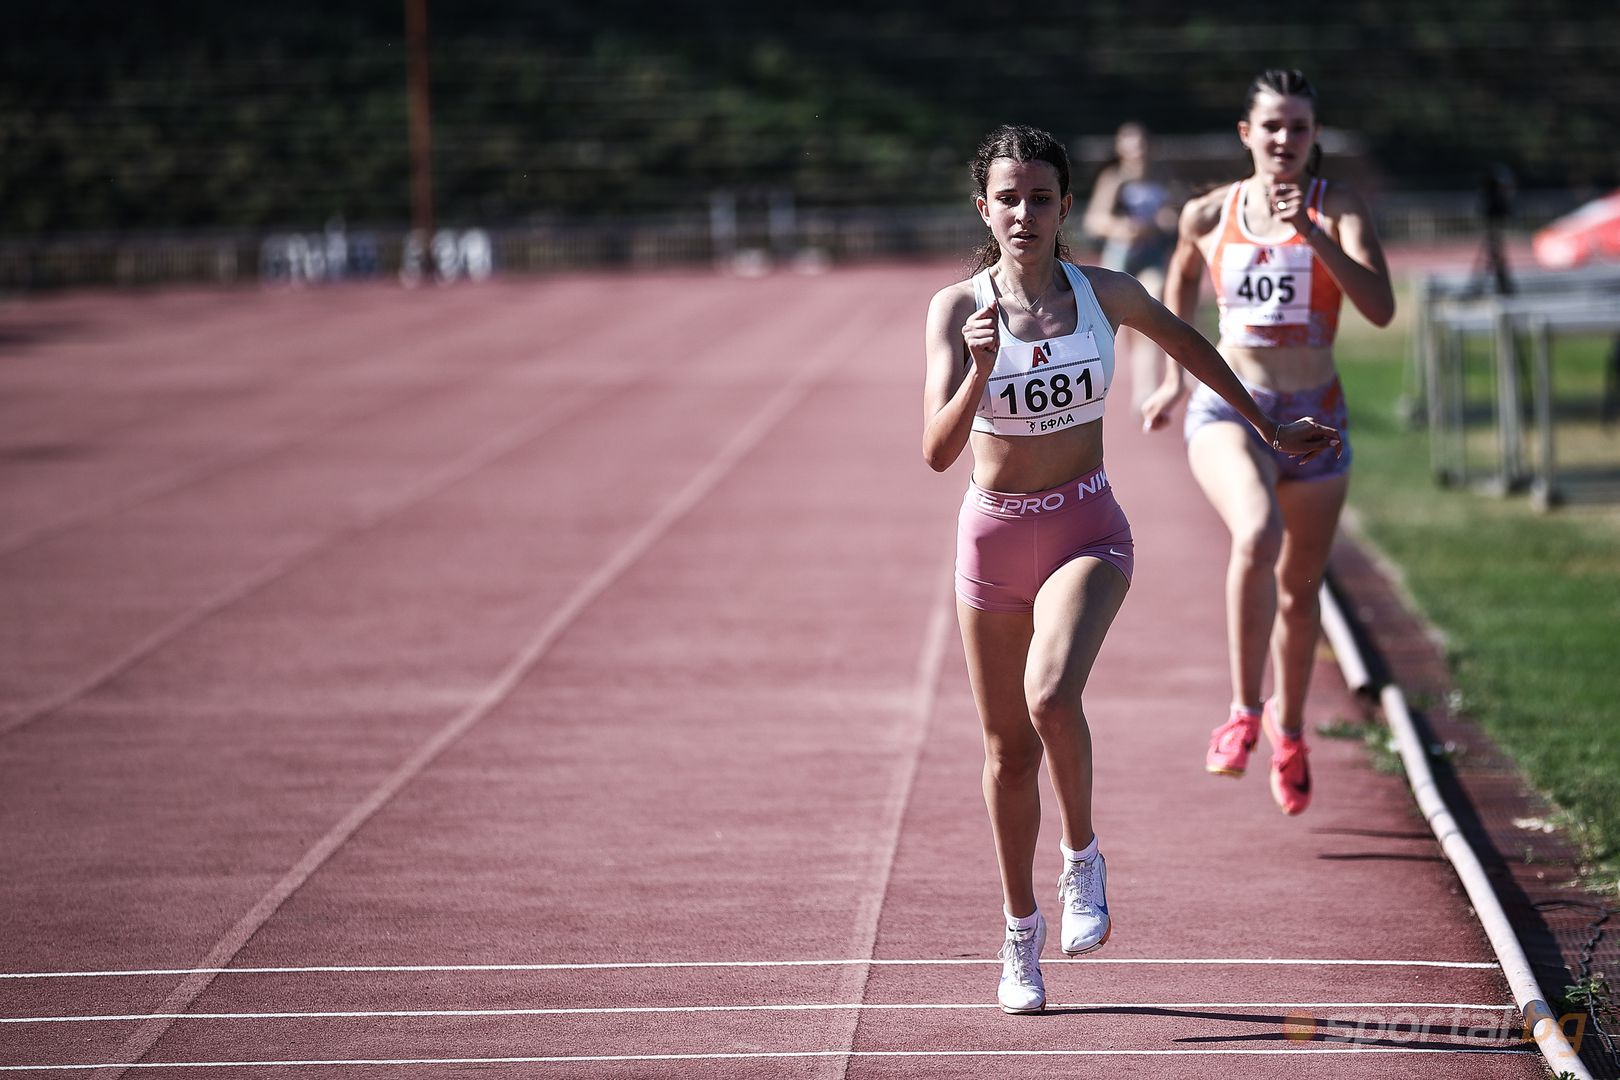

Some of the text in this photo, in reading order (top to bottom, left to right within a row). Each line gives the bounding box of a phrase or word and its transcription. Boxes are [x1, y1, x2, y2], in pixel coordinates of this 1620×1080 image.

[1237, 275, 1295, 303] 405
[1032, 342, 1052, 367] A1
[999, 368, 1094, 415] 1681
[1040, 413, 1075, 431] БФЛА
[1000, 493, 1065, 514] PRO
